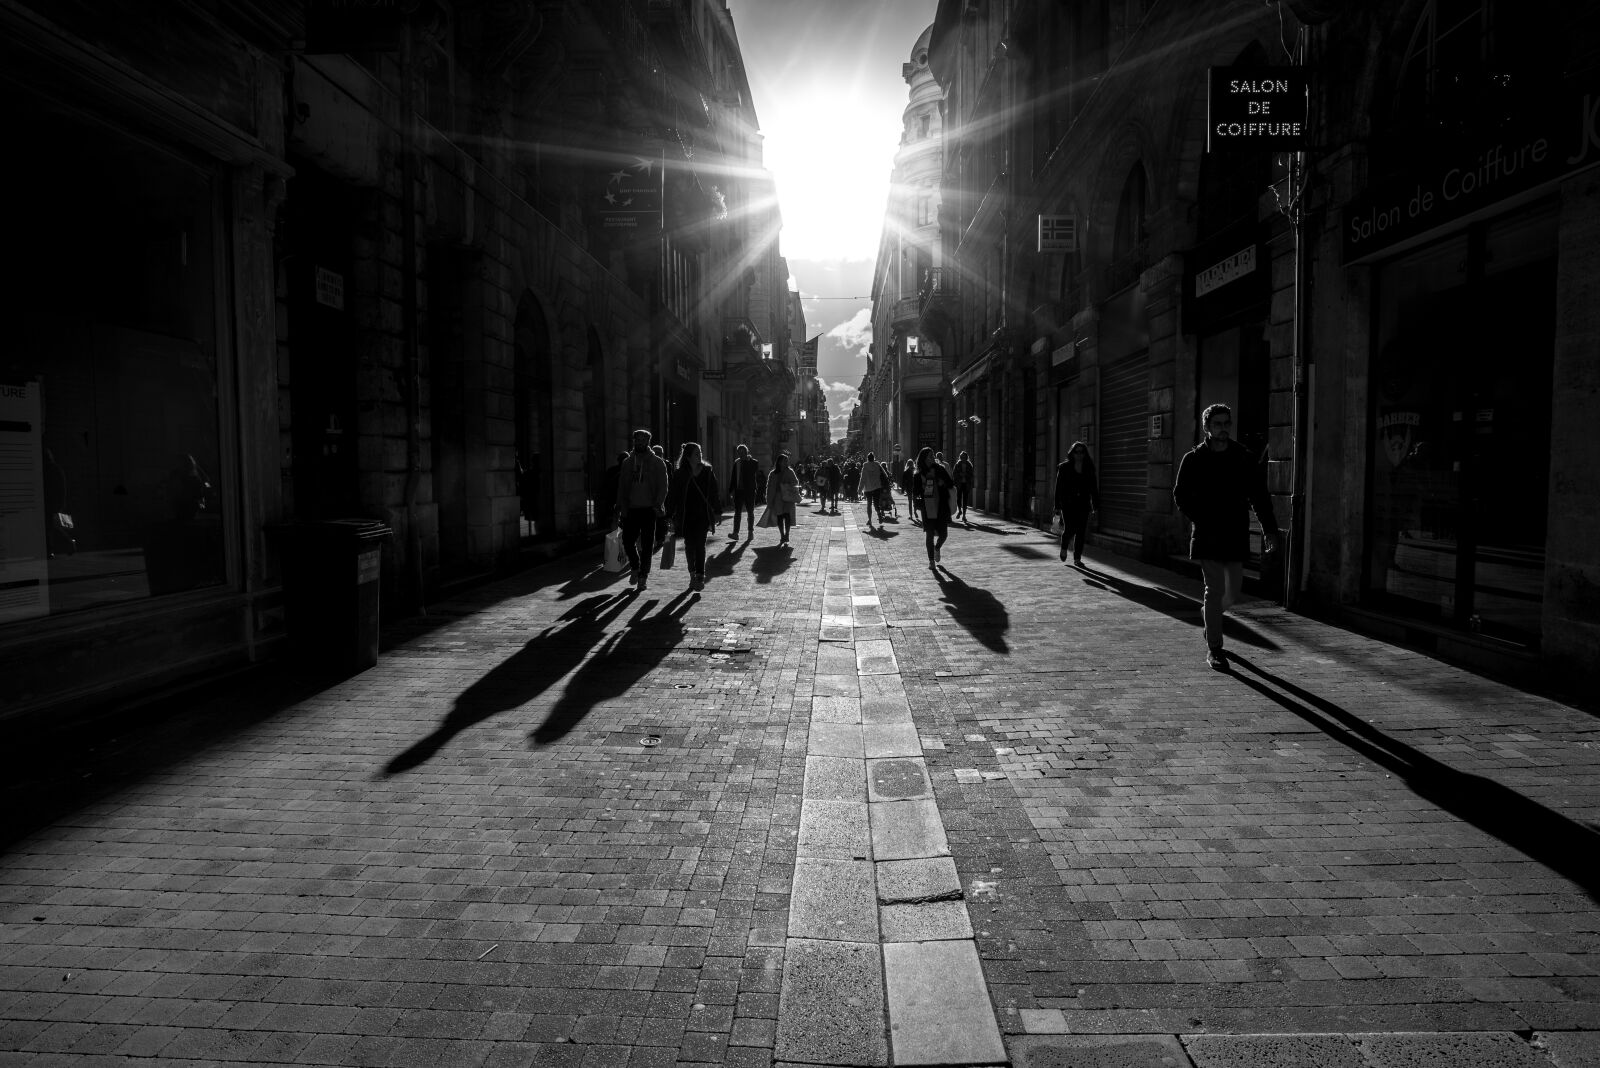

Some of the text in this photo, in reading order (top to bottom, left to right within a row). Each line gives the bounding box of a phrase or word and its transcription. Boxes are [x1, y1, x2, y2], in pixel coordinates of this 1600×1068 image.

[1230, 80, 1288, 93] SALON
[1248, 101, 1271, 115] DE
[1216, 122, 1302, 136] COIFFURE
[1566, 93, 1600, 165] J
[1351, 137, 1549, 243] Salon de Coiffure
[0, 387, 26, 399] URE
